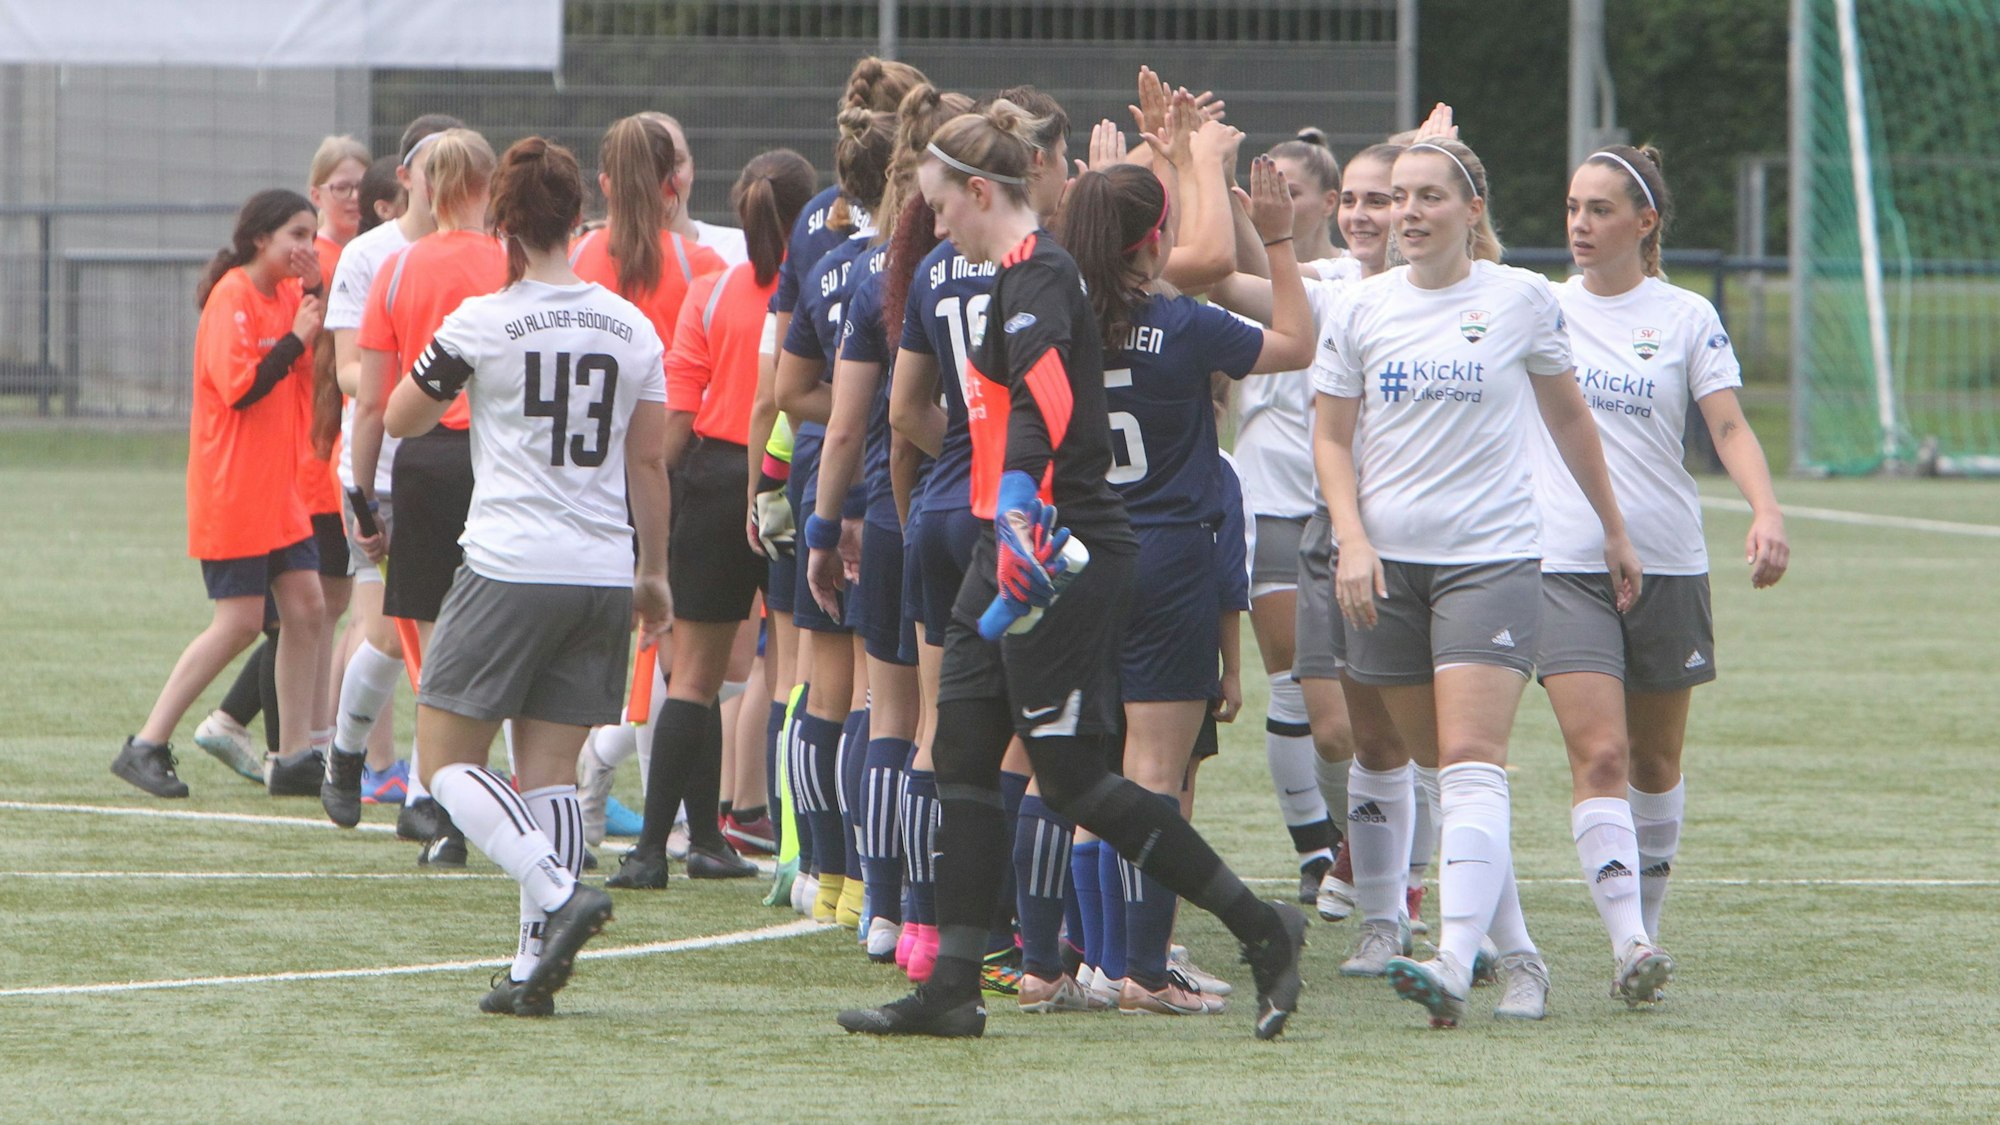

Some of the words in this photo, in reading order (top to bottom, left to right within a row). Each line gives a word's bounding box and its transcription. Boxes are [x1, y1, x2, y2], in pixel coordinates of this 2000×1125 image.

[1118, 325, 1164, 355] DEN
[1641, 329, 1655, 338] SV
[1412, 387, 1482, 403] LikeFord
[524, 351, 619, 467] 43
[1595, 868, 1632, 884] adidas
